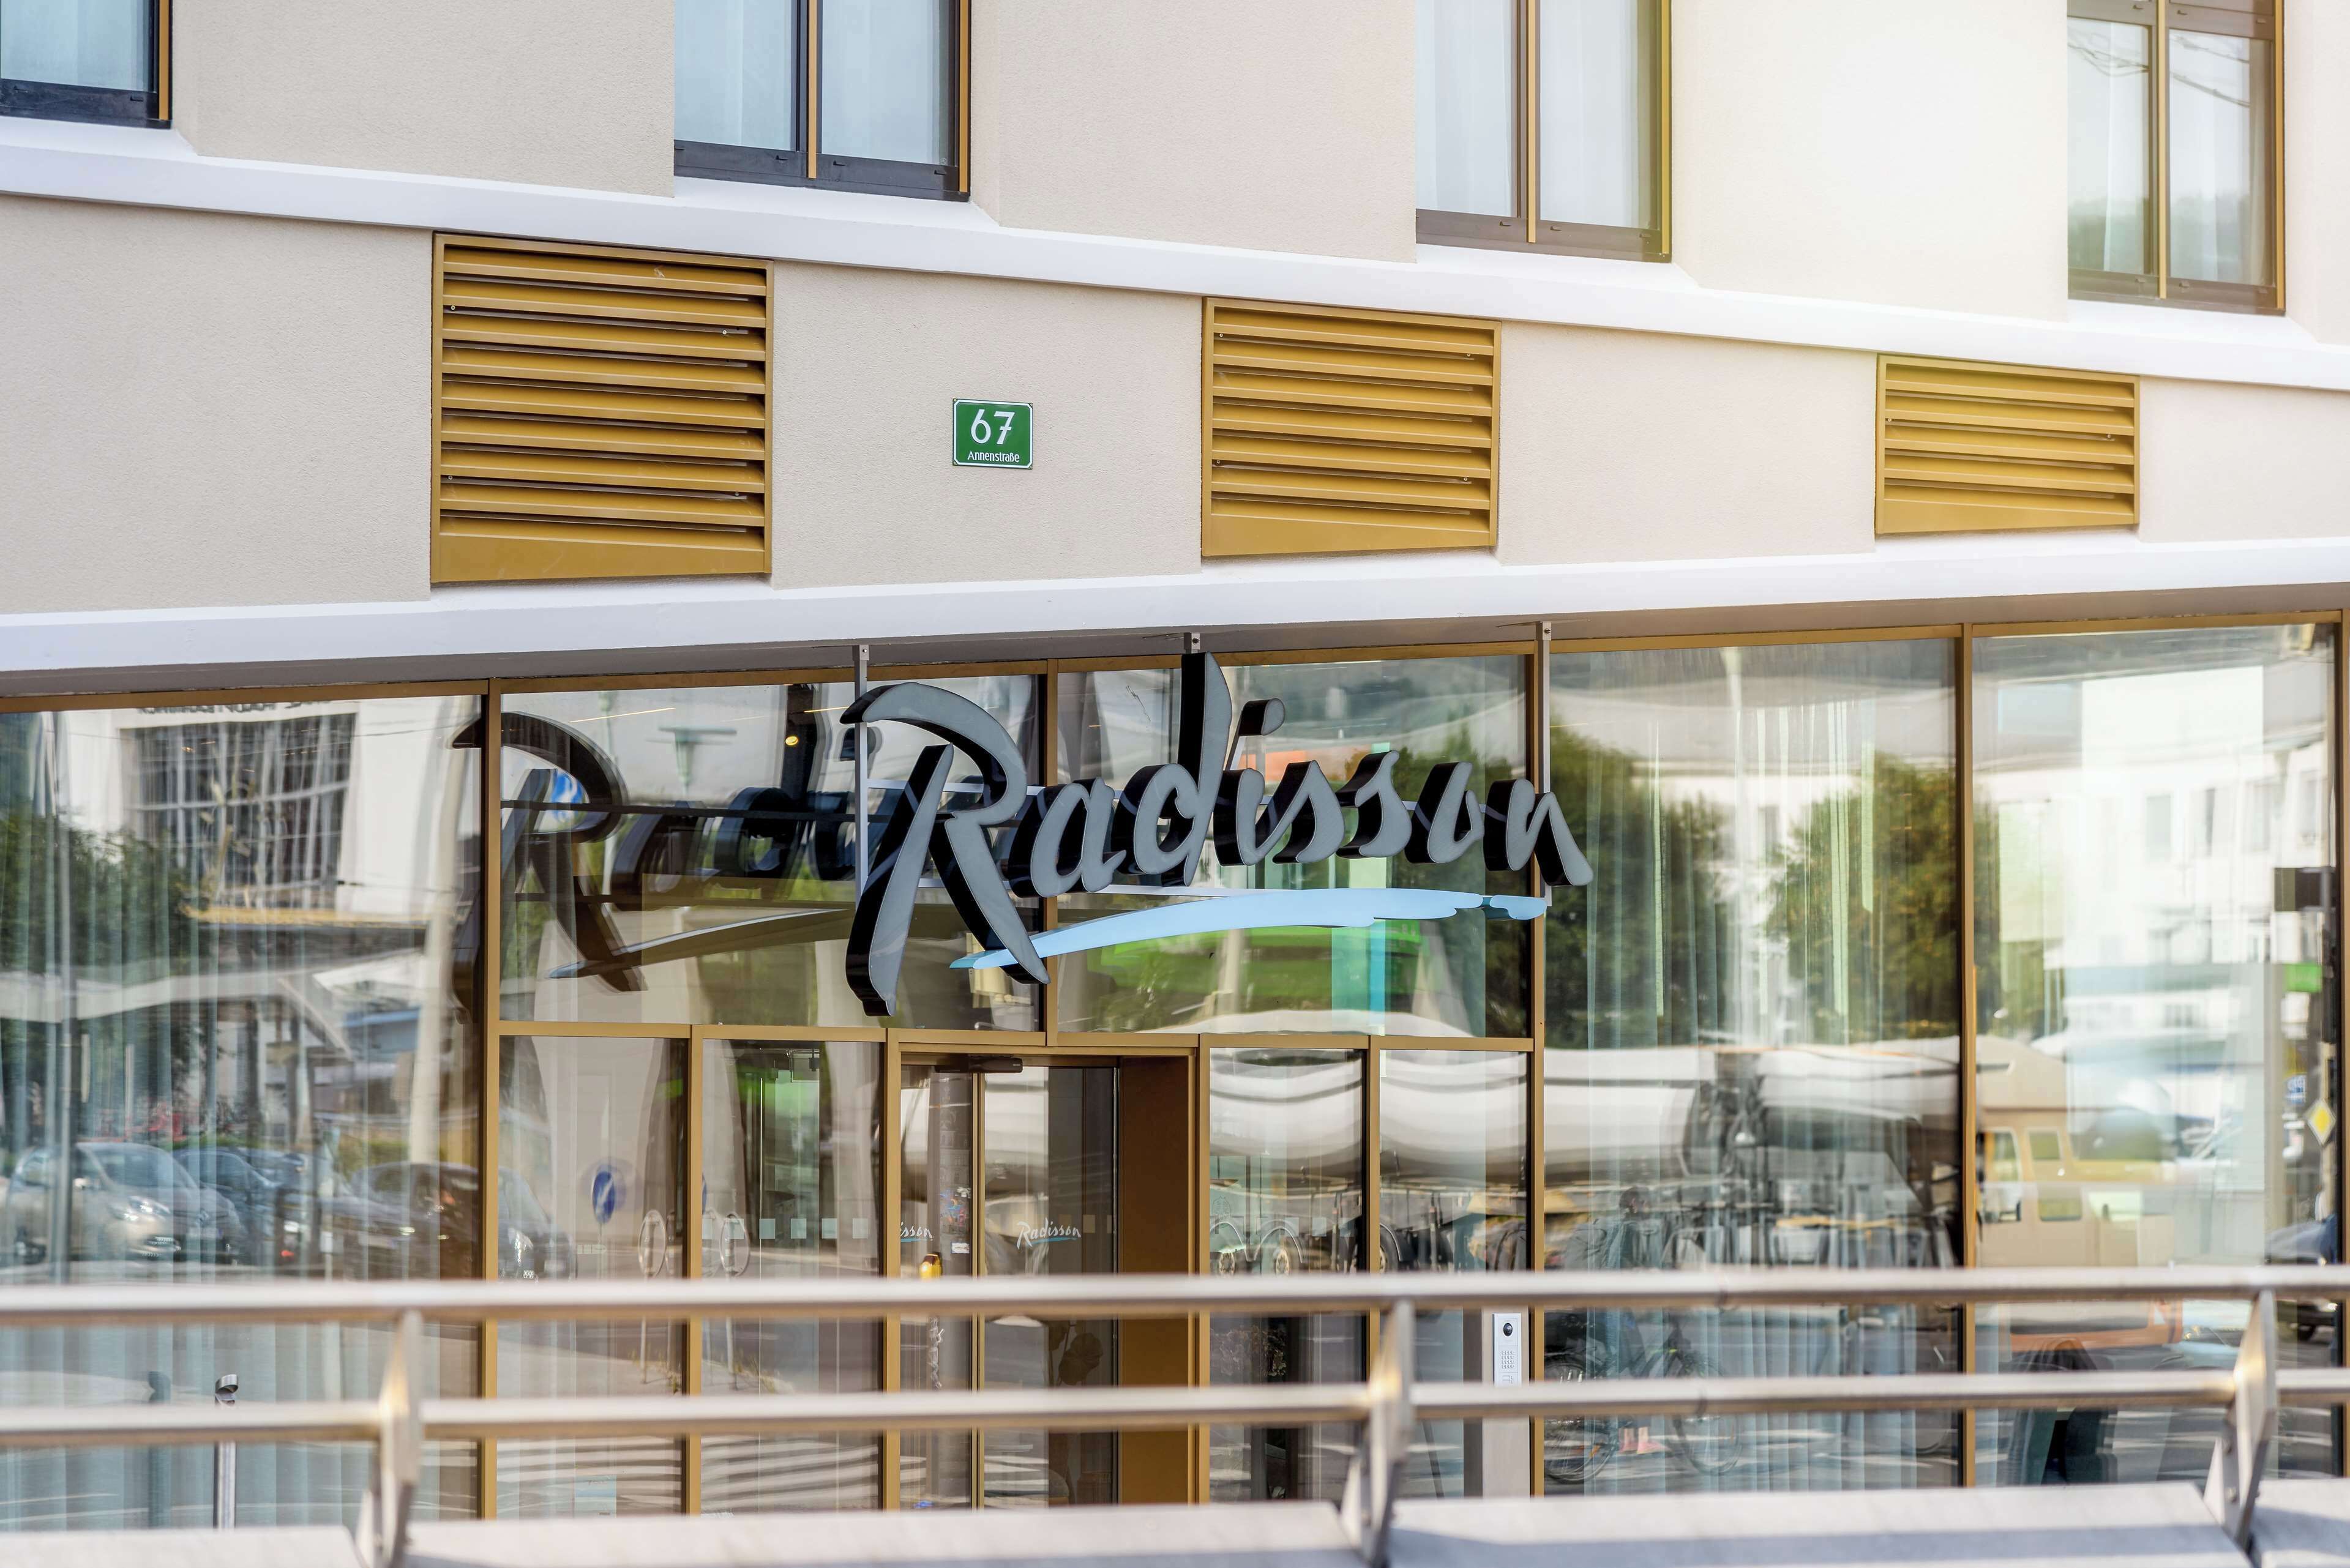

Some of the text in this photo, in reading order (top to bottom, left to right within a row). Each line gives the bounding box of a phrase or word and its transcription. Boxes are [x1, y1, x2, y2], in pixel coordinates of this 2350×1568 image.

[971, 409, 1015, 444] 67
[967, 450, 1020, 463] Annenstraße
[840, 650, 1593, 1017] Radisson
[1016, 1217, 1081, 1250] Radisson
